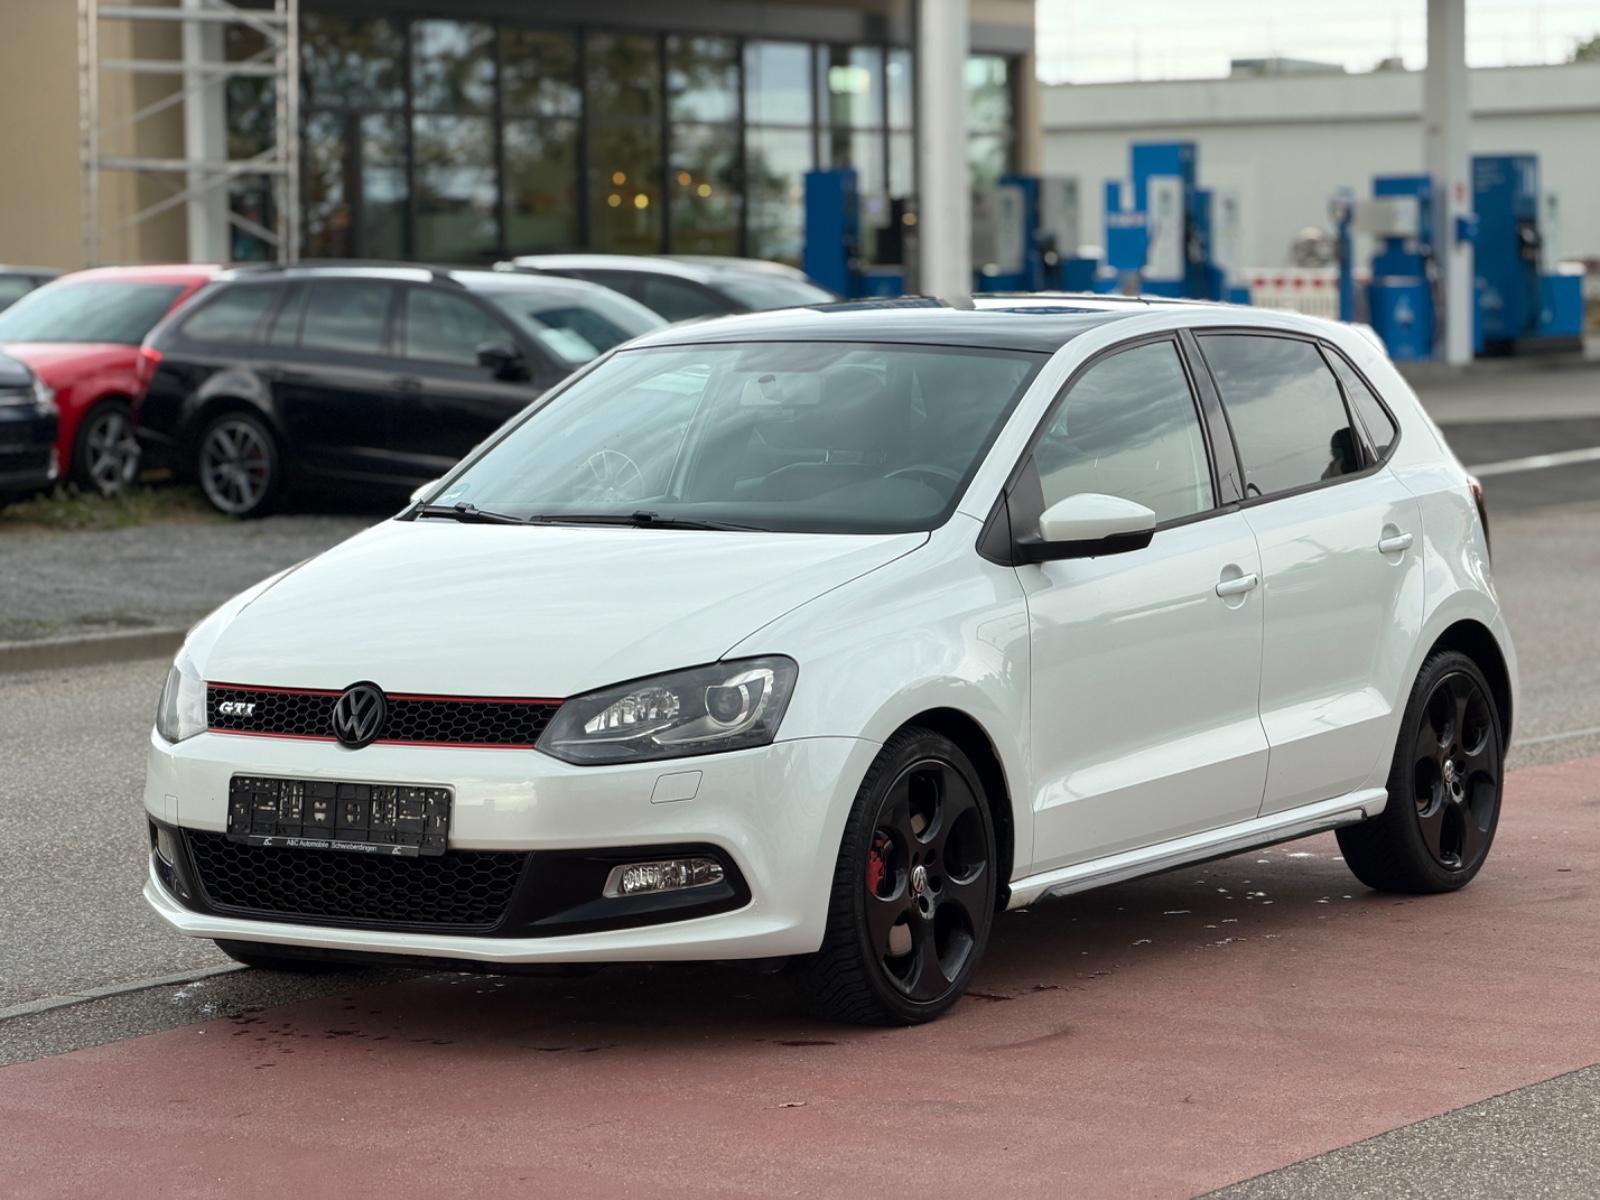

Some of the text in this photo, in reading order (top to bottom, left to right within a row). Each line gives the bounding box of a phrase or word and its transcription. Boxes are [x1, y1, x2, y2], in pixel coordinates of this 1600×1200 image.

[219, 701, 256, 717] GTI
[335, 685, 384, 745] VW
[299, 839, 329, 849] Automobile
